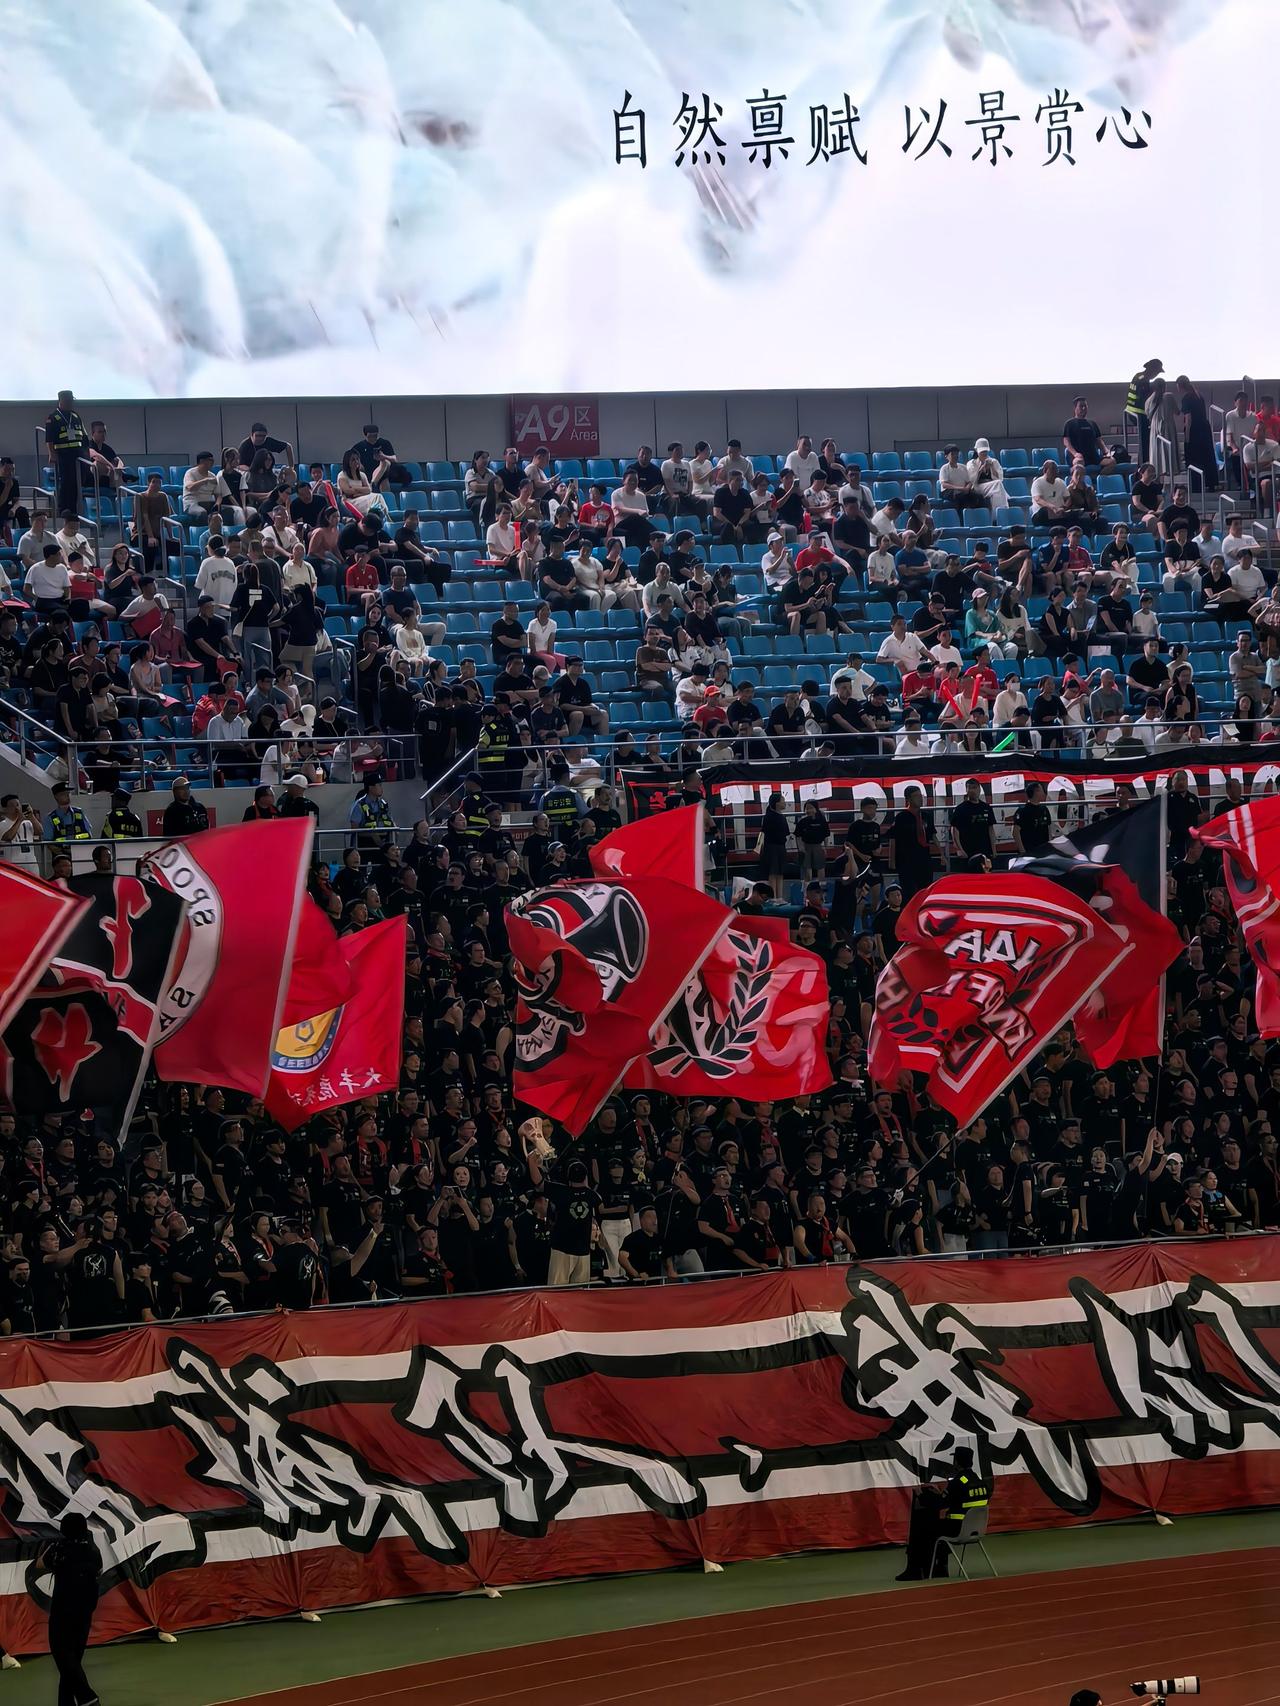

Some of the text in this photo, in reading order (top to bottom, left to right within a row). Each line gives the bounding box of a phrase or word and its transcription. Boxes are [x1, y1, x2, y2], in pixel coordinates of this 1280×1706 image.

[612, 87, 1152, 168] 自然禀赋 以景赏心
[570, 428, 598, 441] Area
